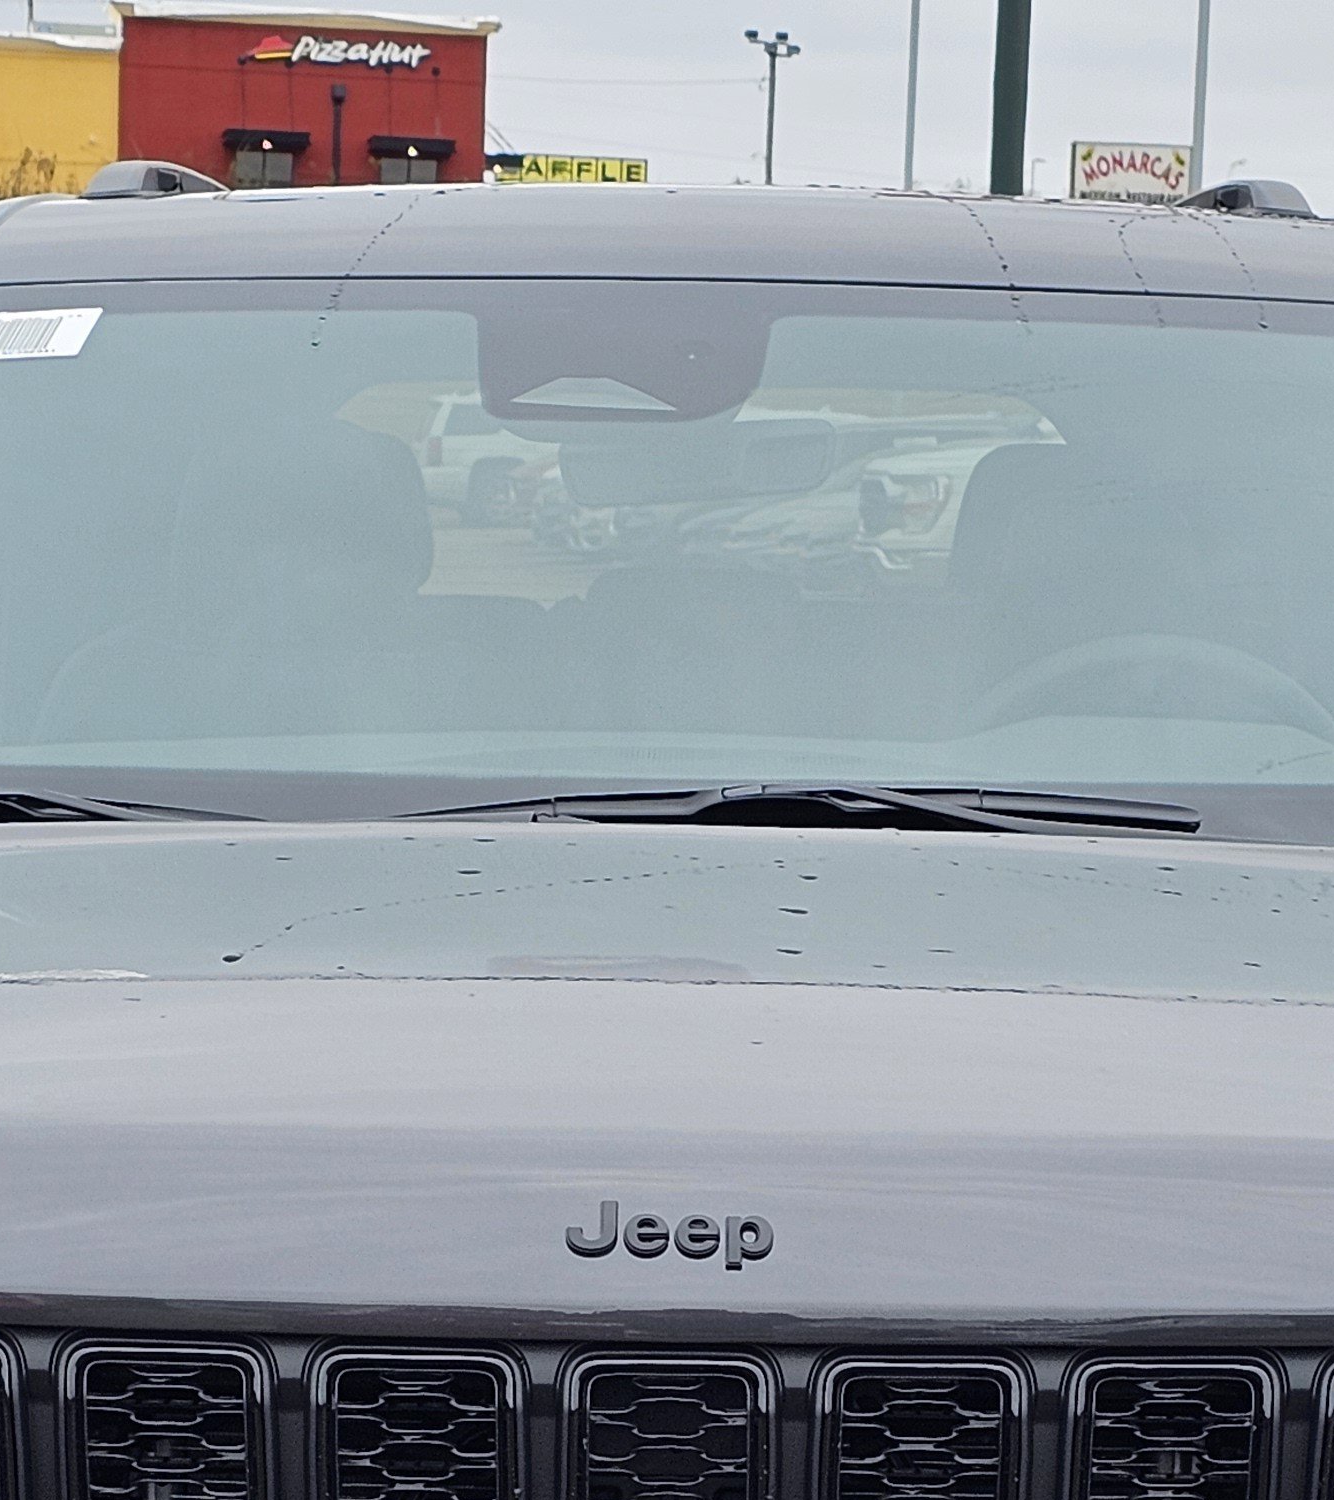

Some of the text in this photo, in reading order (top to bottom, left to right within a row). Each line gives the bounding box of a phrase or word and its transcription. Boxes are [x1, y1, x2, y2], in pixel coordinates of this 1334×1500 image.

[291, 35, 431, 68] Pizza Hut
[524, 155, 643, 183] AFFLE
[1081, 150, 1185, 190] MONARCAS
[565, 1199, 774, 1271] Jeep
